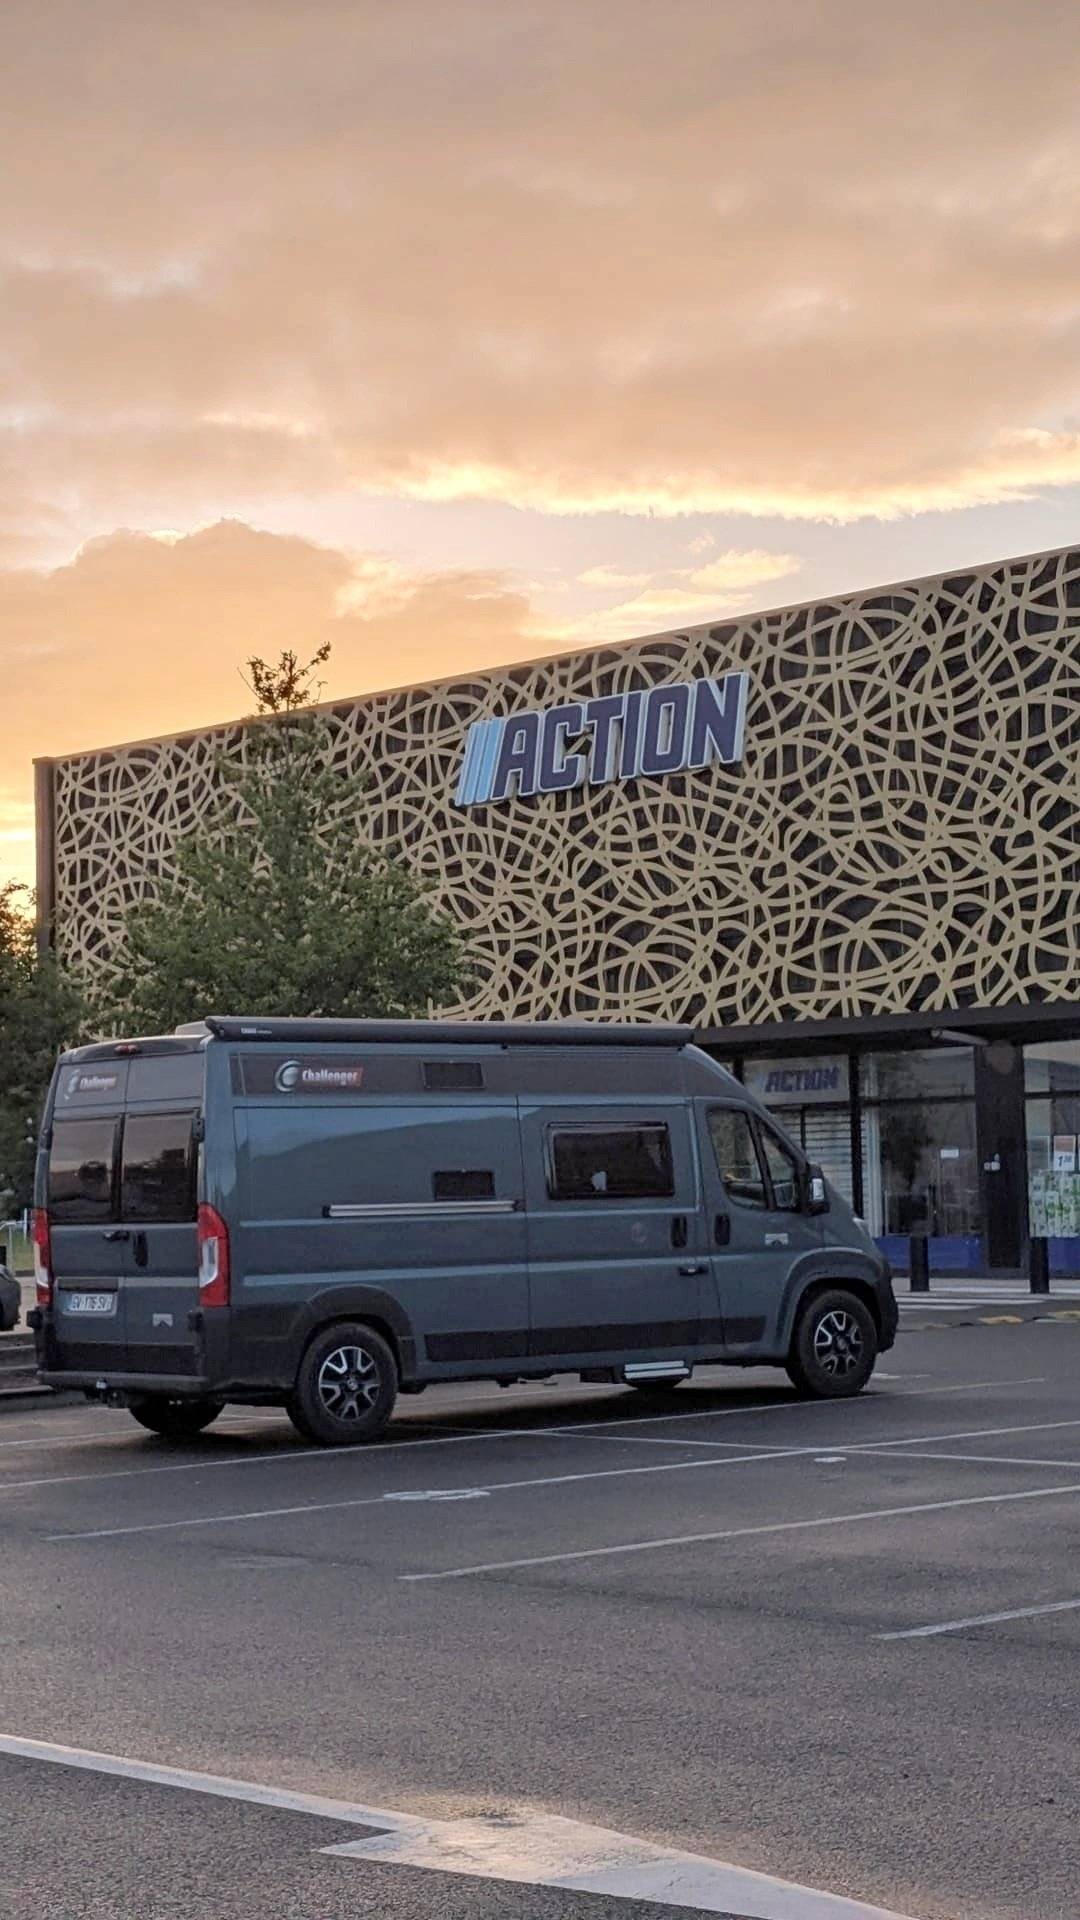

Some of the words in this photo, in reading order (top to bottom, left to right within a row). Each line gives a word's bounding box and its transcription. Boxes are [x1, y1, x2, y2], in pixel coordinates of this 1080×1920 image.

[490, 671, 748, 800] ACTION
[302, 1068, 360, 1086] Challenger
[765, 1064, 840, 1092] ACTION
